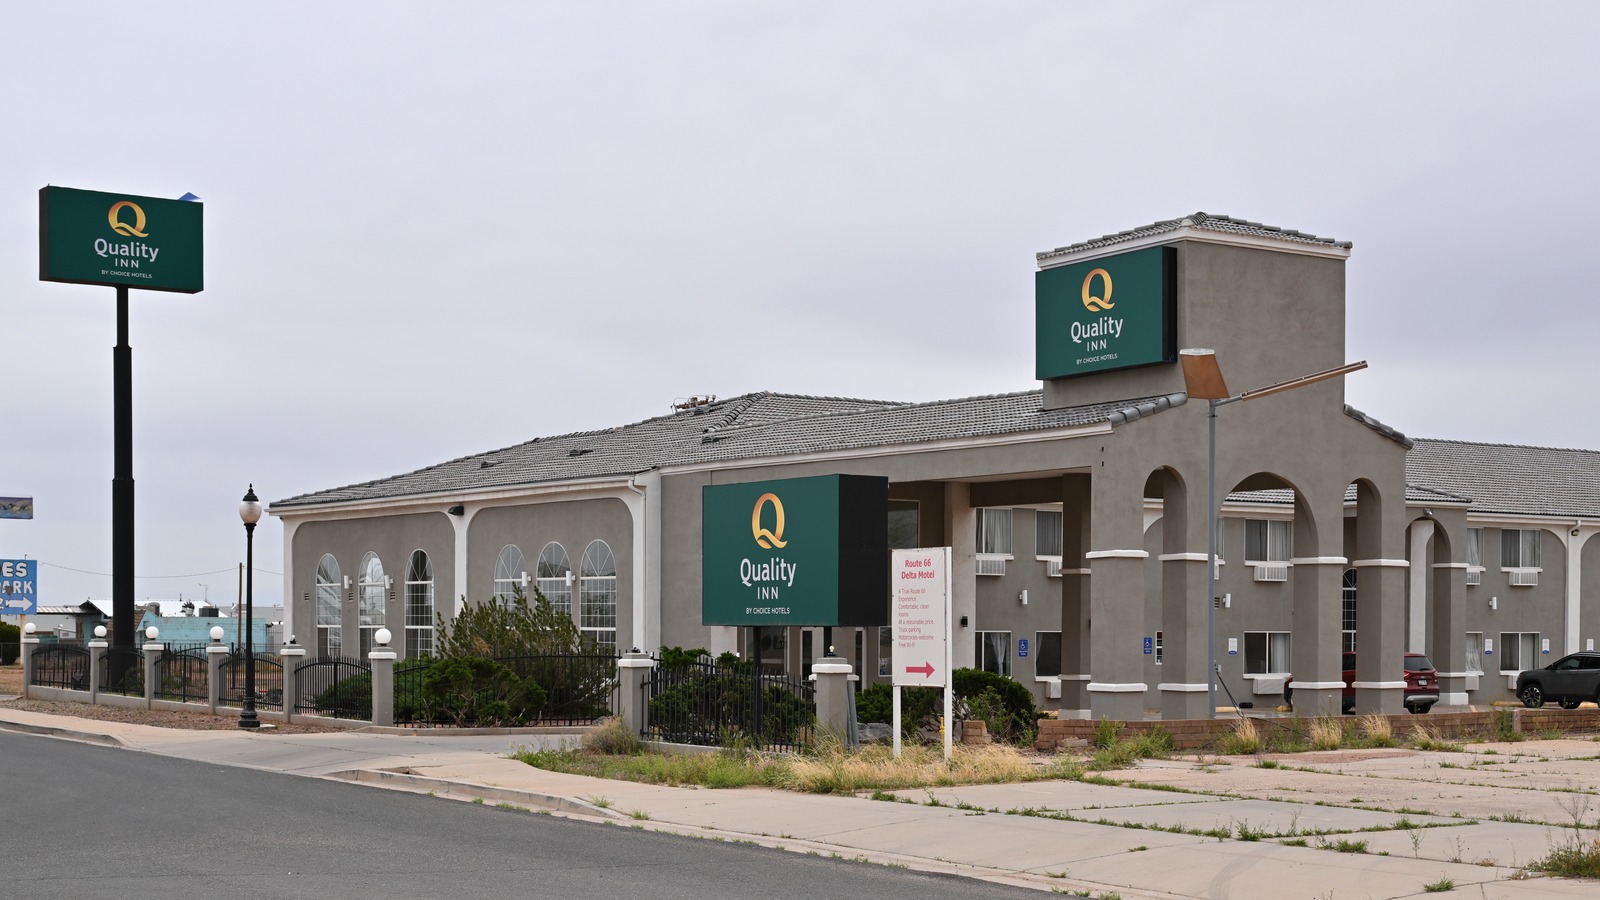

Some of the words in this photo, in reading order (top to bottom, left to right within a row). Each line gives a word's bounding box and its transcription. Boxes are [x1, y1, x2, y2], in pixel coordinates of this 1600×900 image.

[107, 200, 149, 238] Q
[94, 238, 159, 262] Quality
[114, 257, 140, 268] INN
[1081, 267, 1116, 312] Q
[1070, 316, 1124, 344] Quality
[1086, 339, 1107, 352] INN
[1083, 355, 1100, 364] CHOICE
[1100, 353, 1118, 361] HOTELS
[751, 492, 788, 549] Q
[905, 559, 922, 568] Route
[923, 558, 932, 567] 66
[740, 557, 797, 587] Quality
[901, 571, 917, 580] Delta
[918, 570, 935, 579] Motel
[0, 580, 33, 594] ARK
[757, 586, 779, 600] INN
[745, 607, 753, 615] BY
[753, 607, 771, 615] CHOICE
[771, 607, 790, 615] HOTELS
